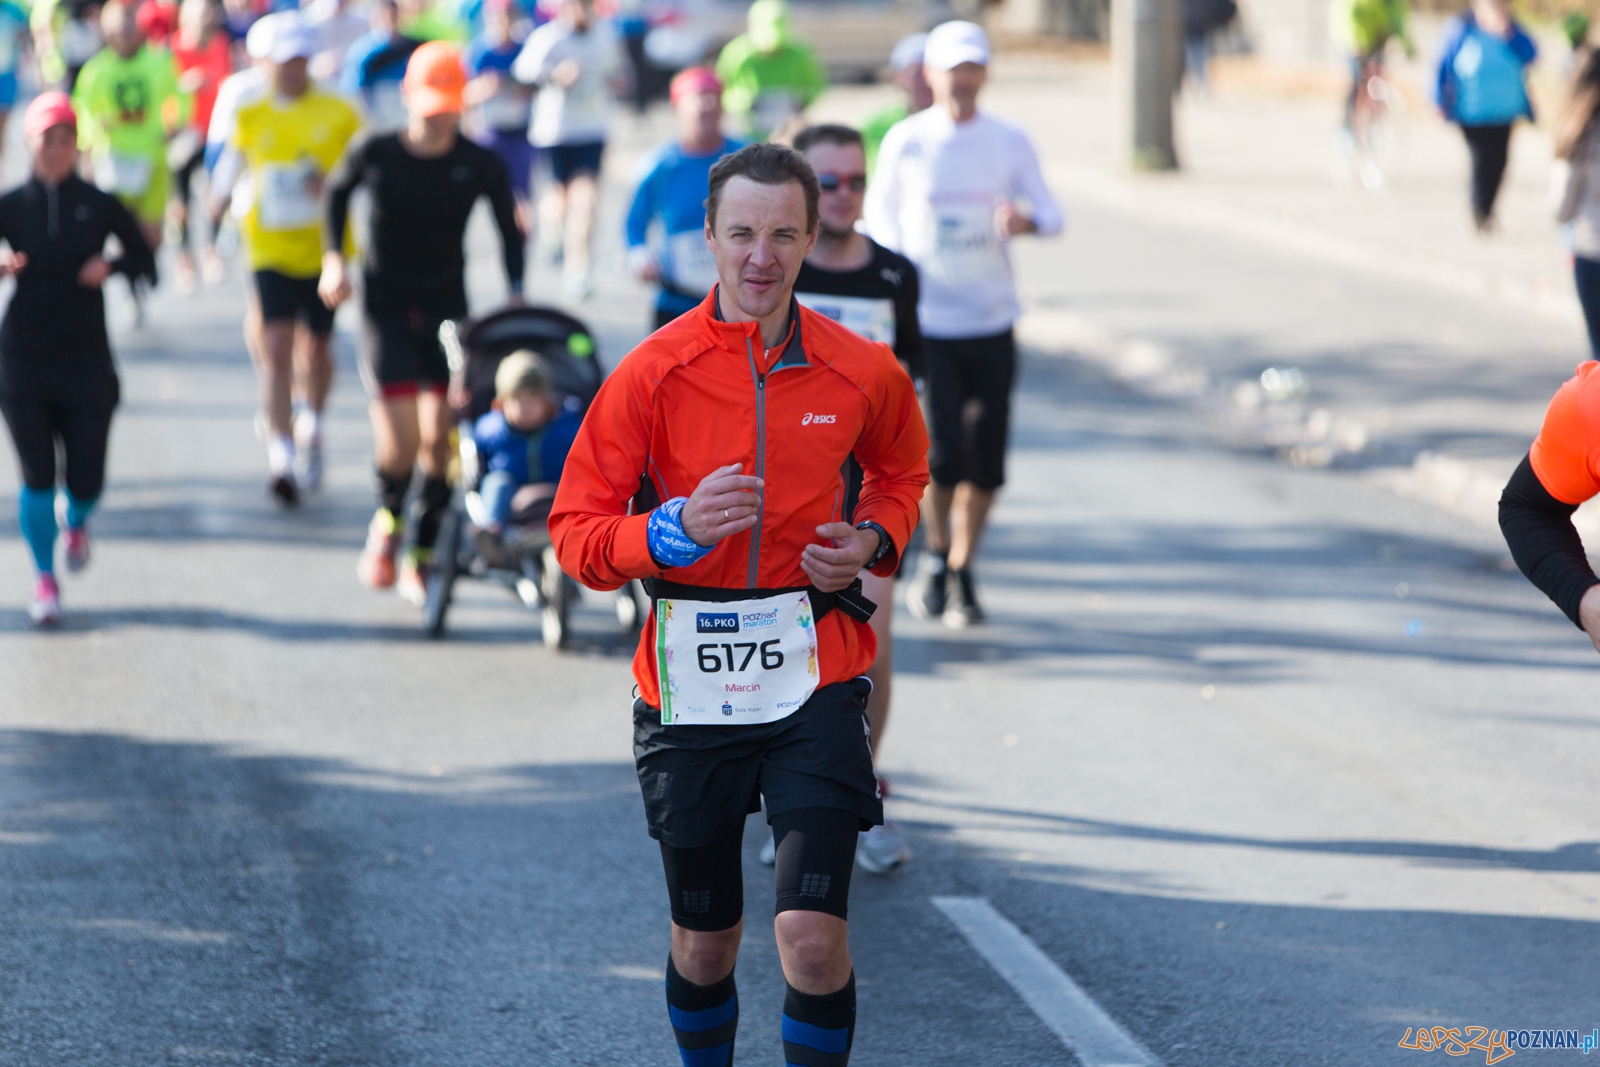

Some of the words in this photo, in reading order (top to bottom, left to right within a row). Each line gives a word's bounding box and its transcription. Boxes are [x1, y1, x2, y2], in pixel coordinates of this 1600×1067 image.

[699, 618, 713, 628] 16.
[714, 618, 736, 628] PKO
[743, 617, 778, 629] maraton
[697, 639, 784, 673] 6176
[725, 683, 761, 692] Marcin
